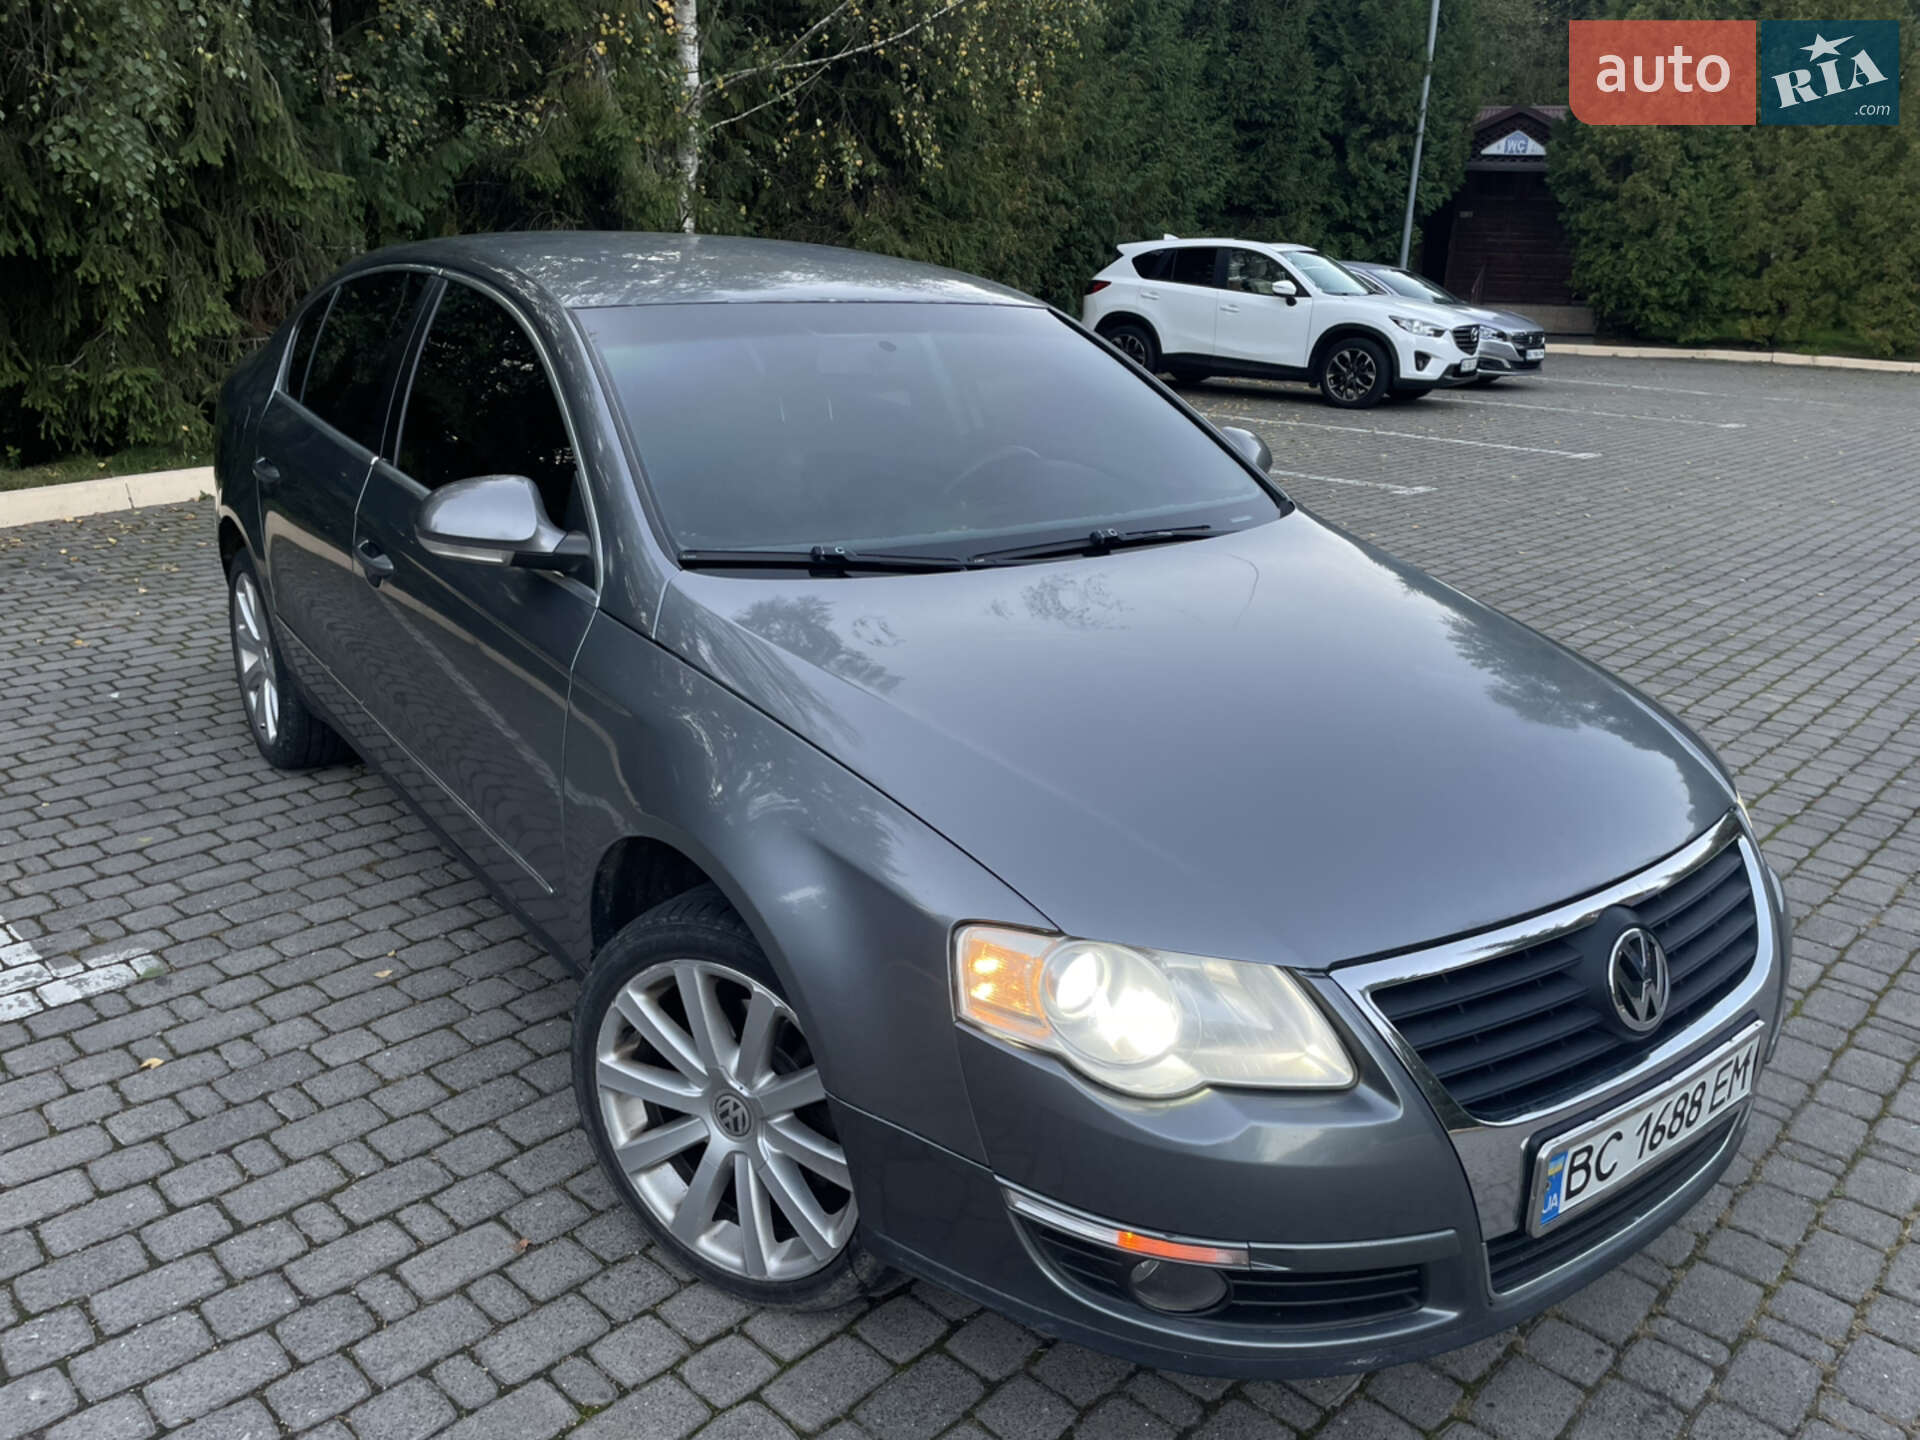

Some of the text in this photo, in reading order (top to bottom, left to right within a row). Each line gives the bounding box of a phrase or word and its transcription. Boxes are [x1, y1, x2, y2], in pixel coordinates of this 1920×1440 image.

[1507, 139, 1526, 152] WC
[1565, 1046, 1752, 1202] BC 1688 EM
